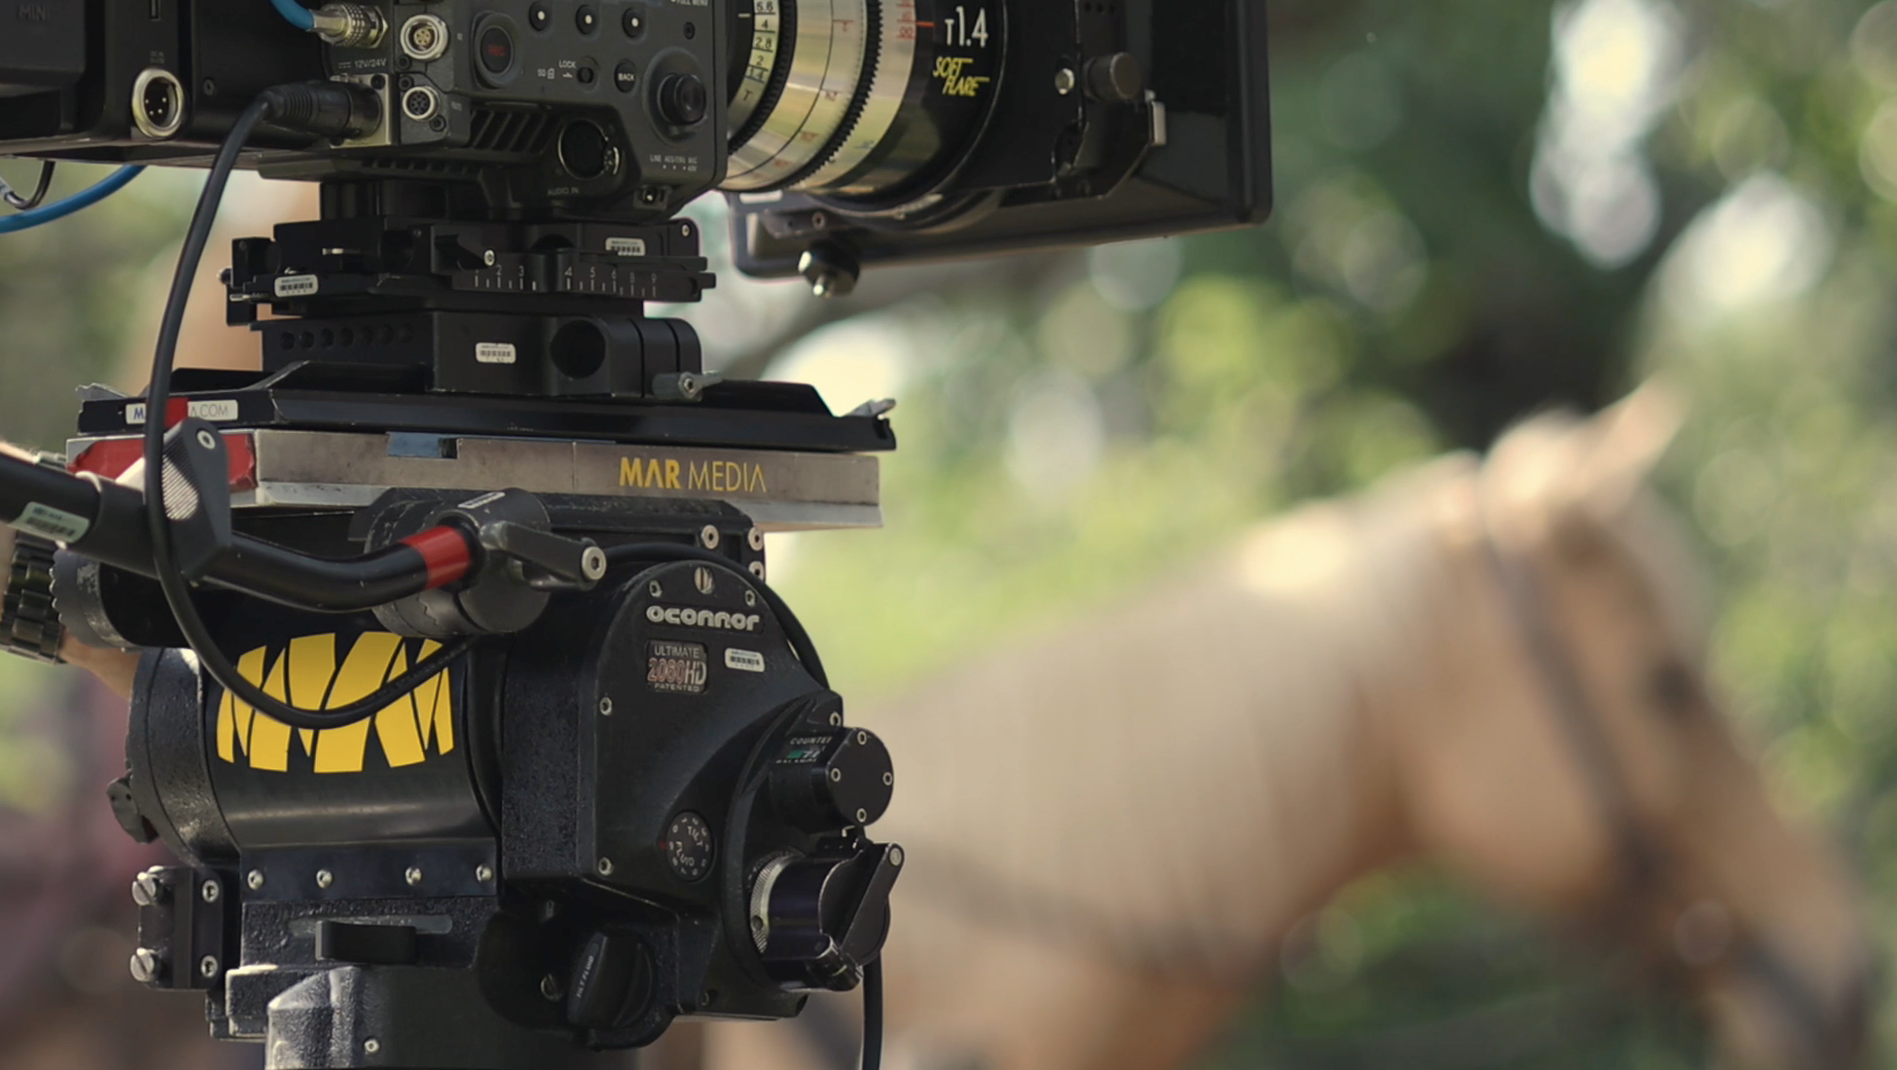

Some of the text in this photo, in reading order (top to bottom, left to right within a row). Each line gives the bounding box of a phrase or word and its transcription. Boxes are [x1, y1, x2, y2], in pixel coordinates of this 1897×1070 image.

[756, 0, 773, 12] 5.6
[761, 19, 769, 30] 4
[755, 36, 772, 48] 2.8
[559, 60, 577, 69] LOCK
[932, 56, 974, 78] SOFT
[617, 73, 635, 81] BACK
[564, 266, 573, 277] 4
[589, 267, 596, 278] 5
[619, 456, 767, 493] MAR MEDIA
[653, 645, 700, 658] ULTIMATE
[653, 683, 700, 692] PATENTED
